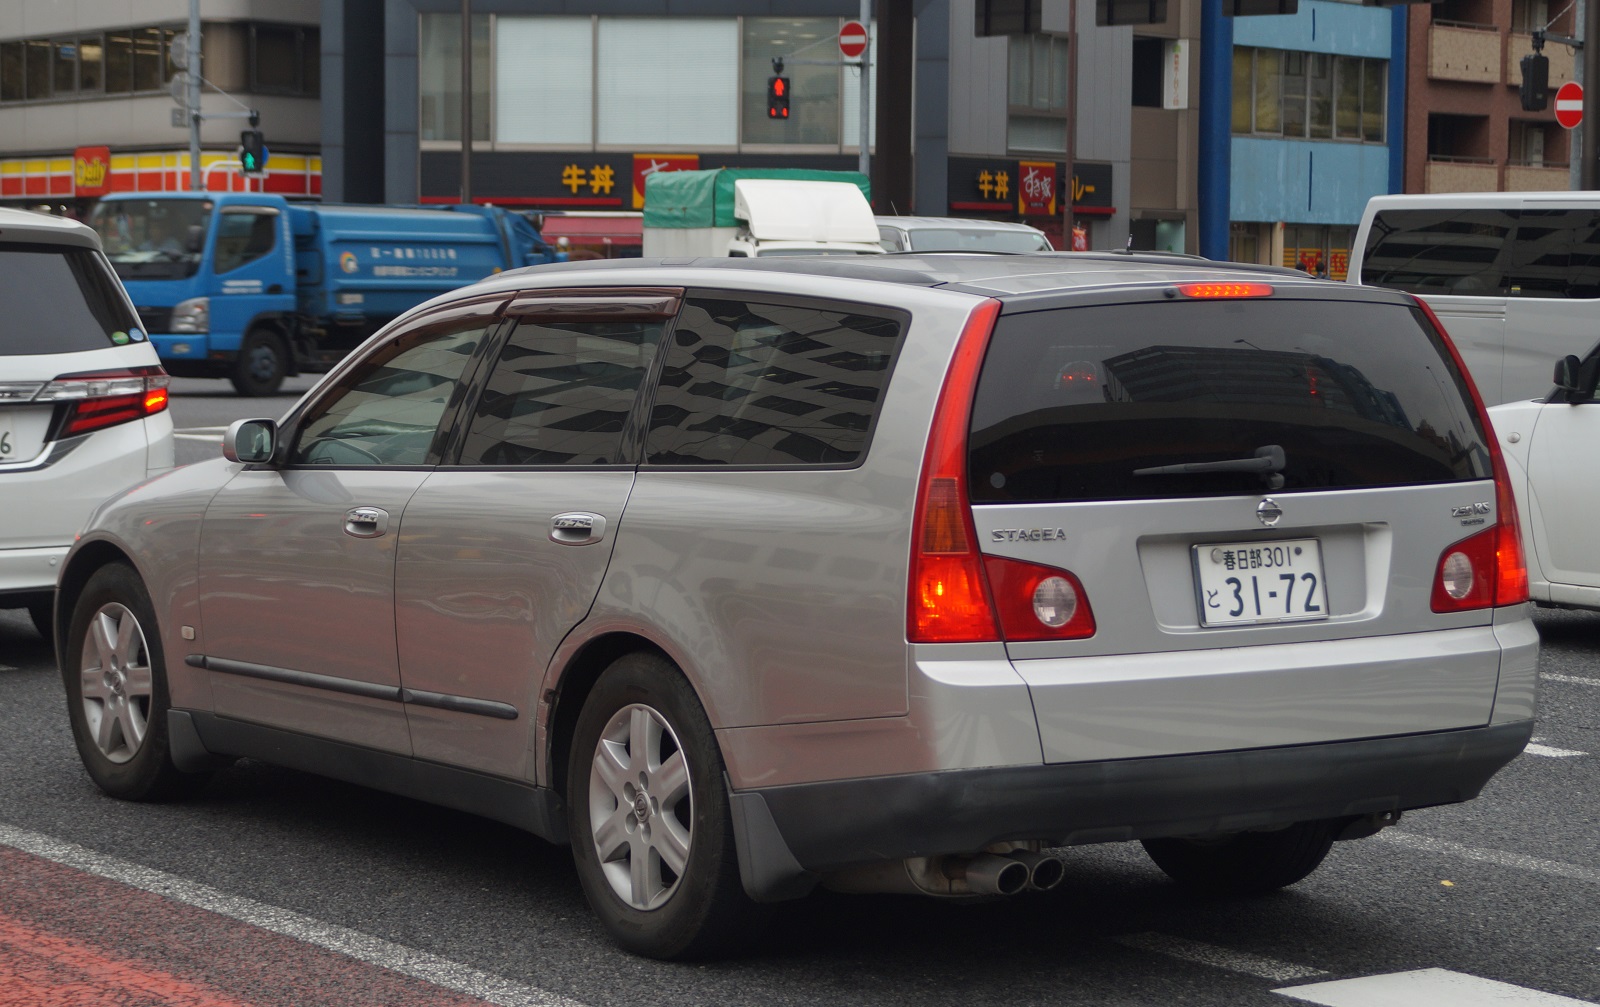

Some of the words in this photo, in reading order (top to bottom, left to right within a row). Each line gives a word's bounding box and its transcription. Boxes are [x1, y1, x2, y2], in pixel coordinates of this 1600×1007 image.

[75, 157, 107, 187] Daily
[562, 164, 615, 194] 牛丼
[979, 170, 1009, 199] 牛丼
[1023, 166, 1052, 200] すき家
[1071, 175, 1095, 201] レー
[992, 528, 1066, 542] STAGEA
[1206, 588, 1221, 608] と
[1225, 572, 1320, 617] 31-72
